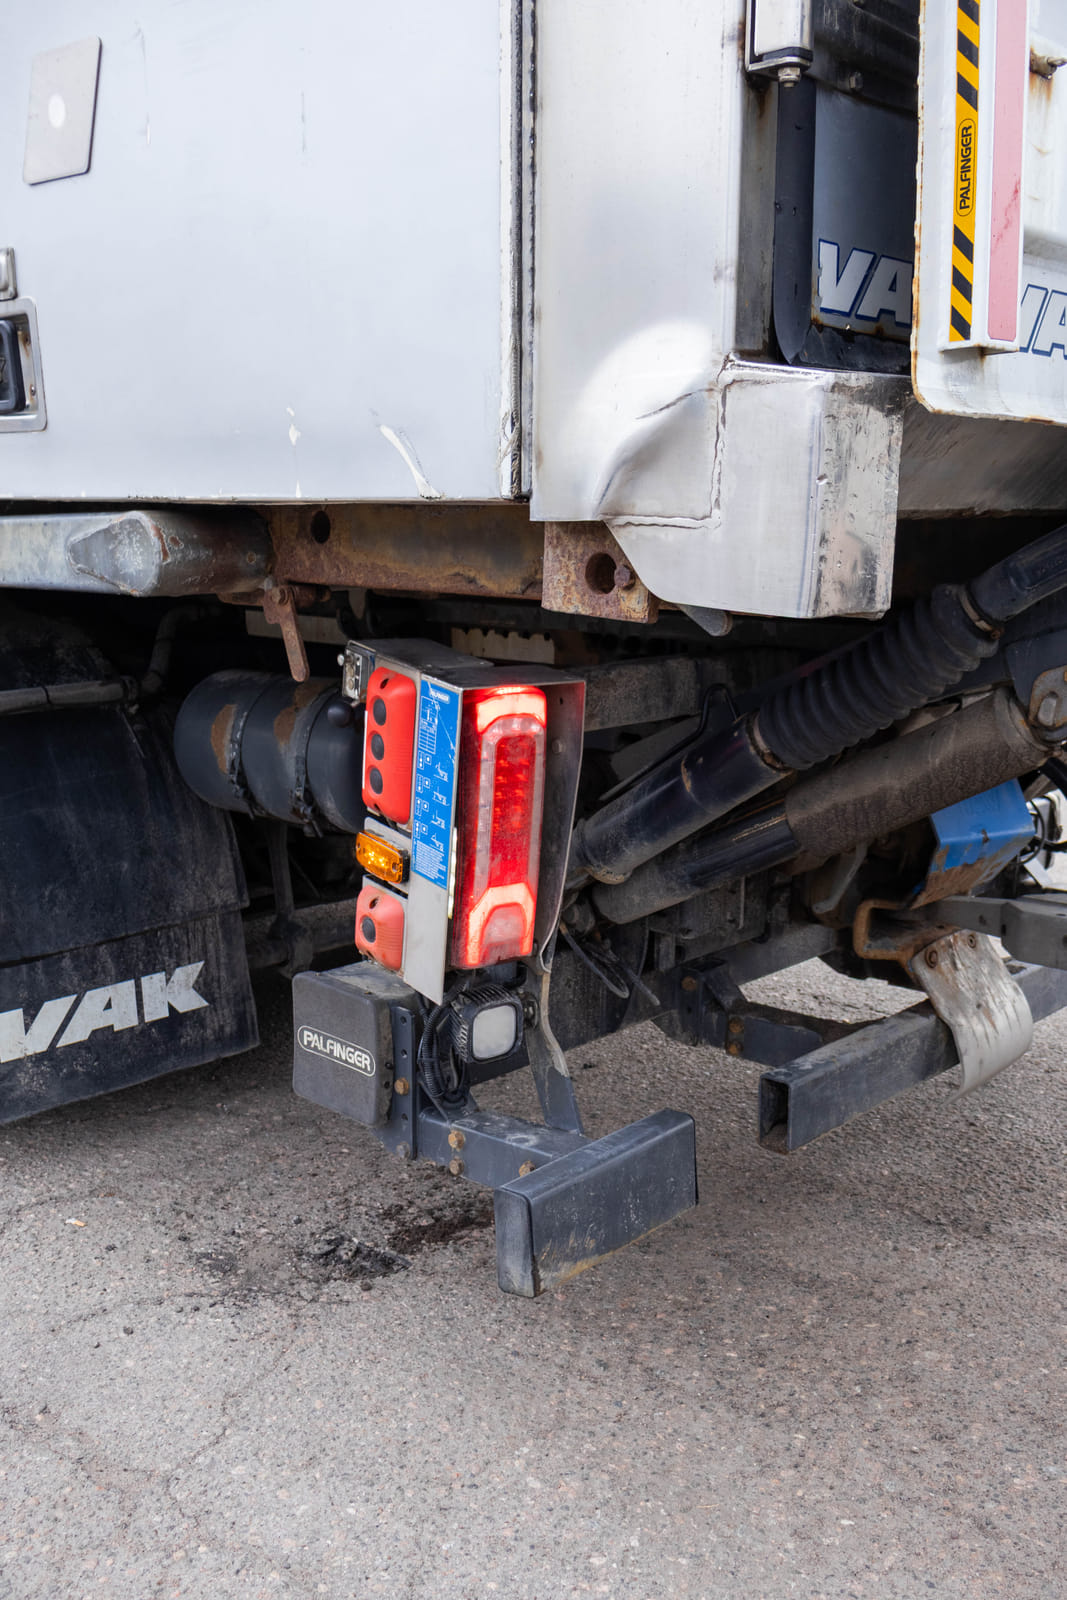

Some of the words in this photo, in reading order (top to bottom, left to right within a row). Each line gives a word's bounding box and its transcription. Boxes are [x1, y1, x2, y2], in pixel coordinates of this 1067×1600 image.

[959, 125, 972, 210] PALFINGER
[0, 960, 209, 1063] VAK
[303, 1030, 371, 1072] PALFINGER
